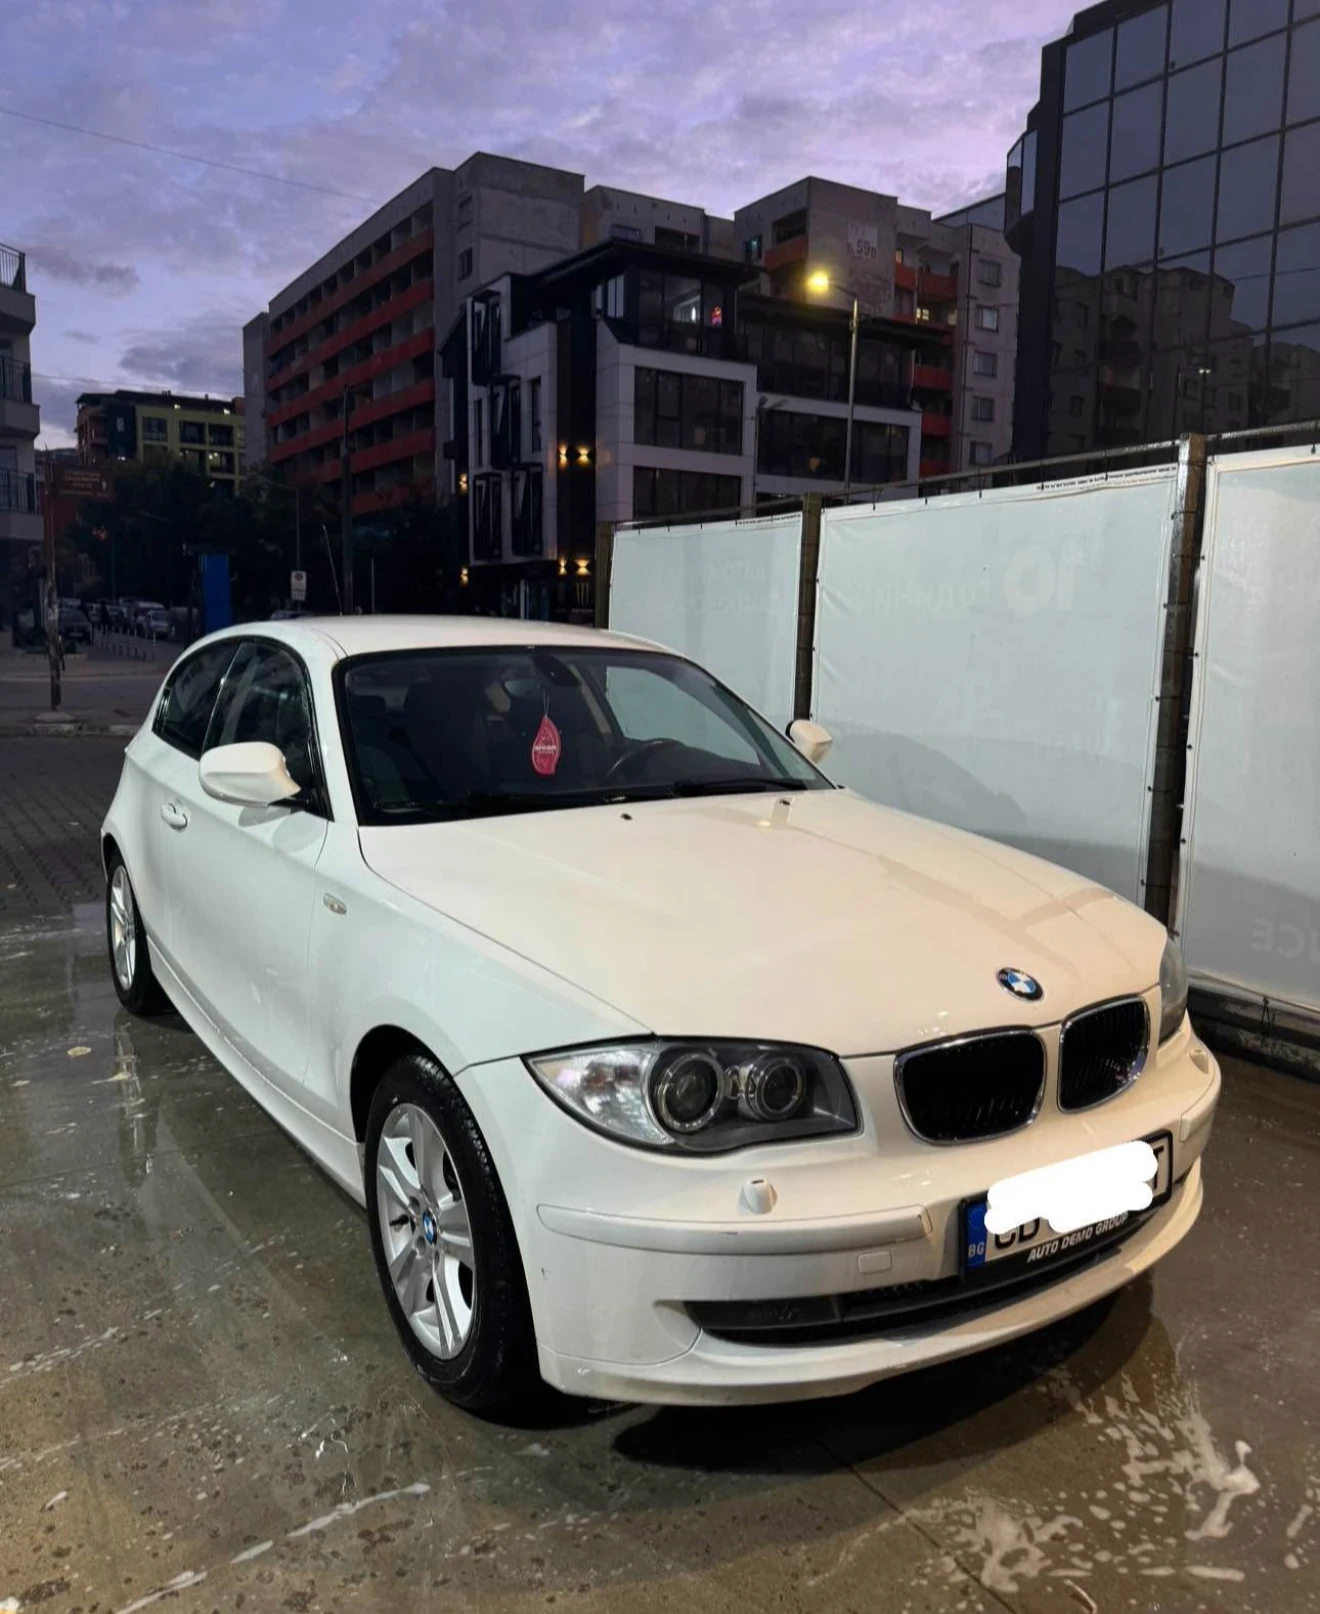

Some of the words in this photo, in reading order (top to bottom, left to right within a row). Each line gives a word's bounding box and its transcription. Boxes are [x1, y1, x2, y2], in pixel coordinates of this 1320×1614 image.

[968, 1241, 985, 1258] BG
[1027, 1240, 1059, 1263] AUTO
[1060, 1228, 1093, 1248] DEMO
[1095, 1211, 1129, 1235] GROUP
